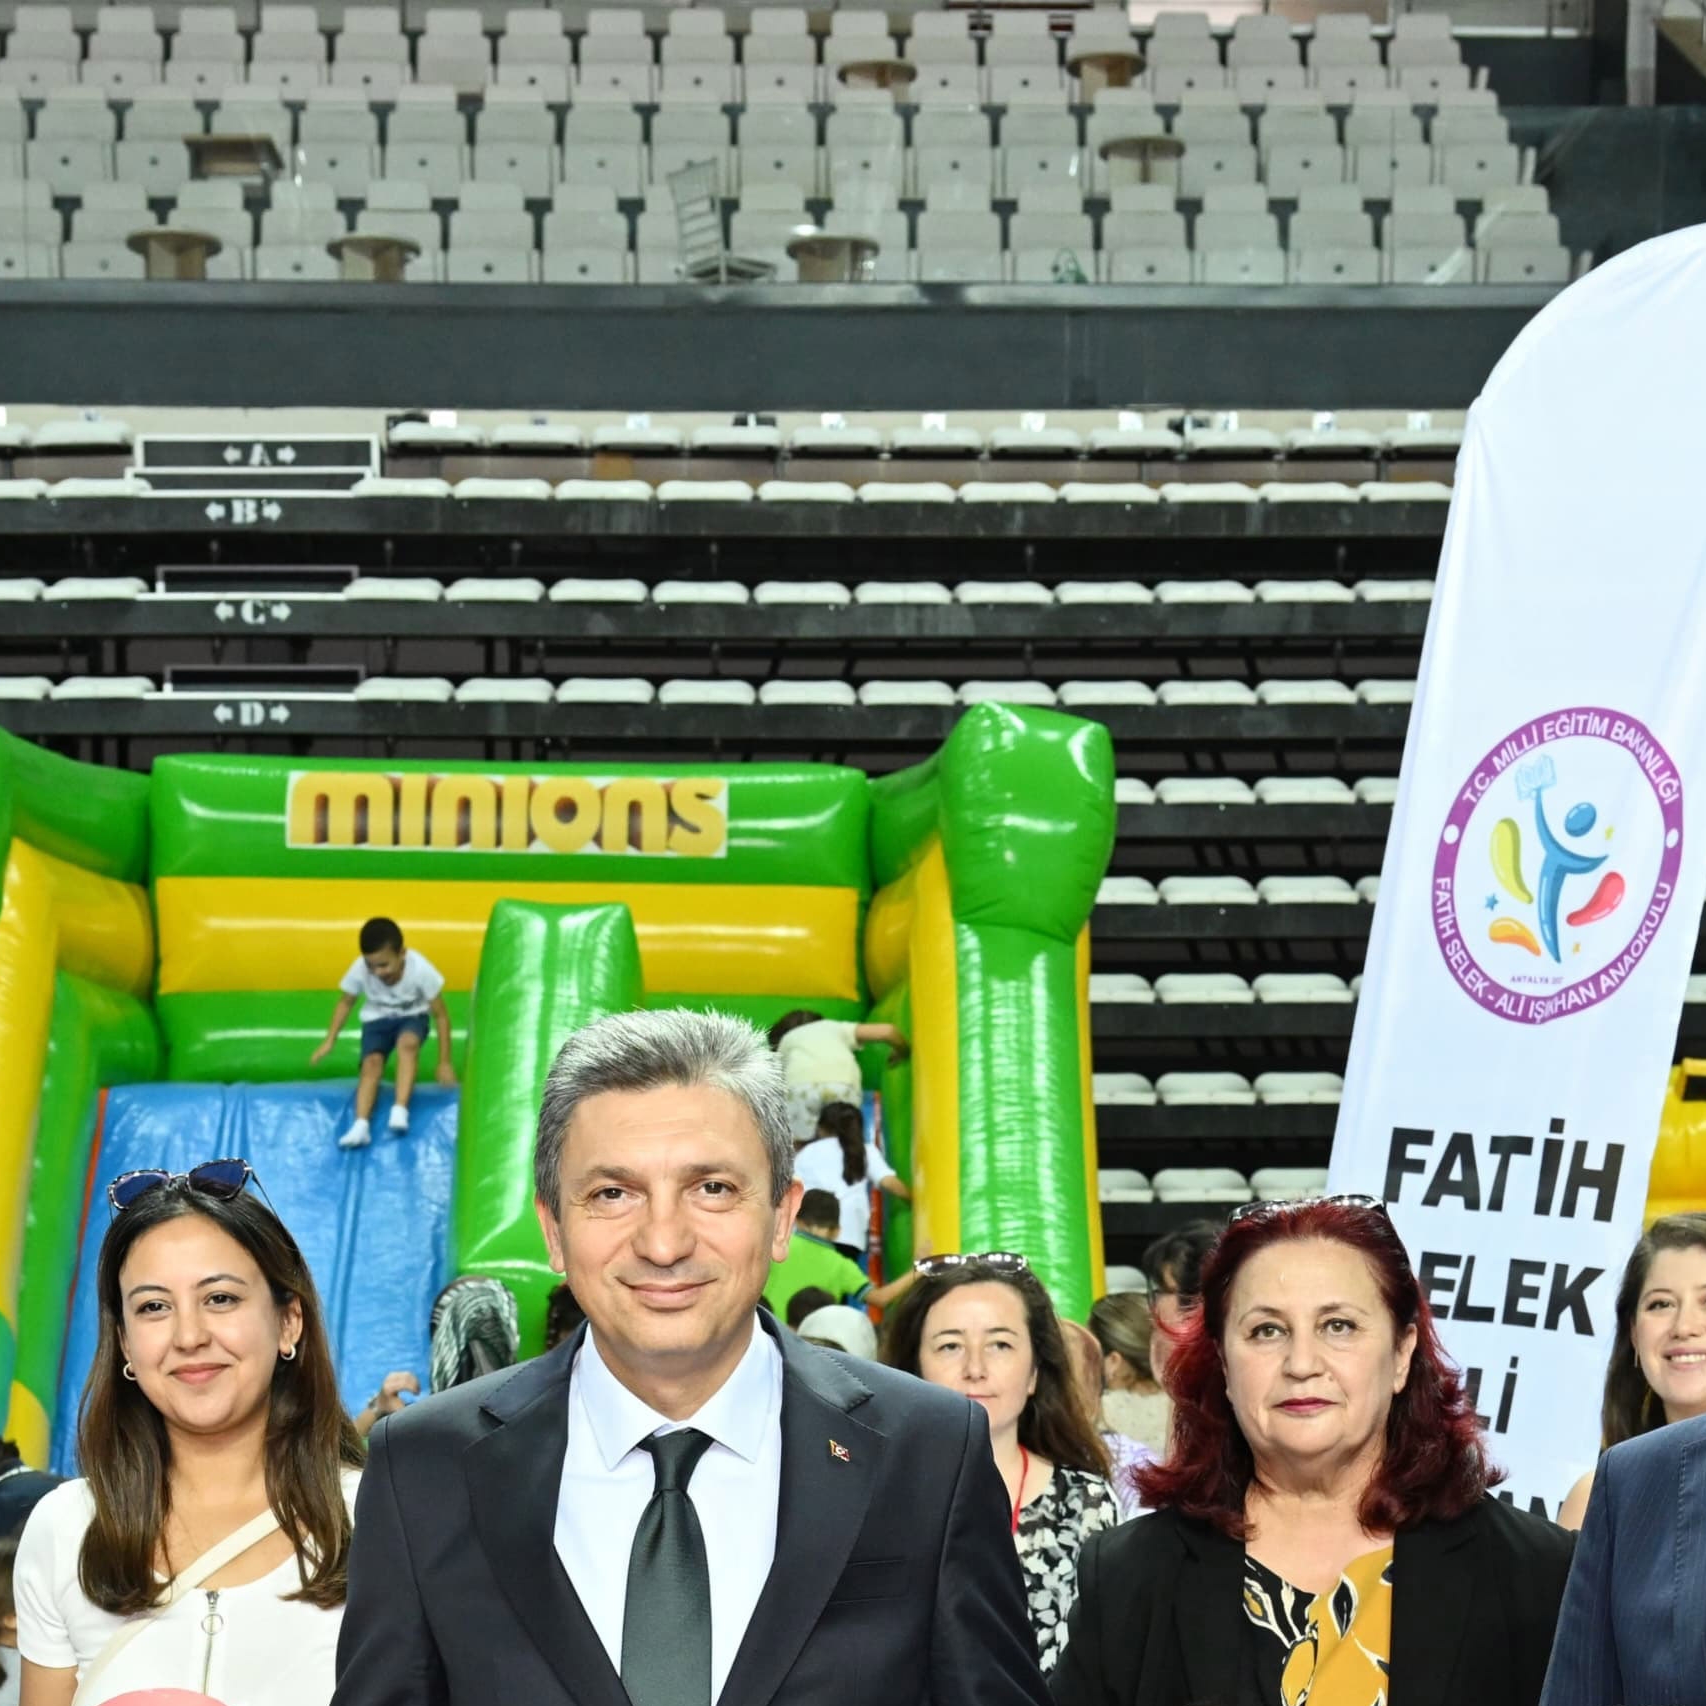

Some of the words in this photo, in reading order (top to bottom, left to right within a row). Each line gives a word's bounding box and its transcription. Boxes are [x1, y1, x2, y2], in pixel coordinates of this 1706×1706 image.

[249, 443, 272, 466] A
[231, 499, 258, 524] B
[240, 600, 267, 625] C
[239, 701, 266, 726] D
[1462, 772, 1494, 805] T.C.
[1492, 724, 1539, 773] MİLLİ
[1542, 712, 1610, 743] EĞİTİM
[1611, 720, 1680, 805] BAKANLIĞI
[1434, 876, 1455, 938] FATİH
[1445, 937, 1488, 999] SELEK
[1495, 993, 1524, 1019] ALİ
[1600, 881, 1671, 996] ANAOKULU
[1383, 1117, 1625, 1223] FATİH
[1417, 1250, 1606, 1337] ELEK
[1465, 1355, 1519, 1434] Lİ
